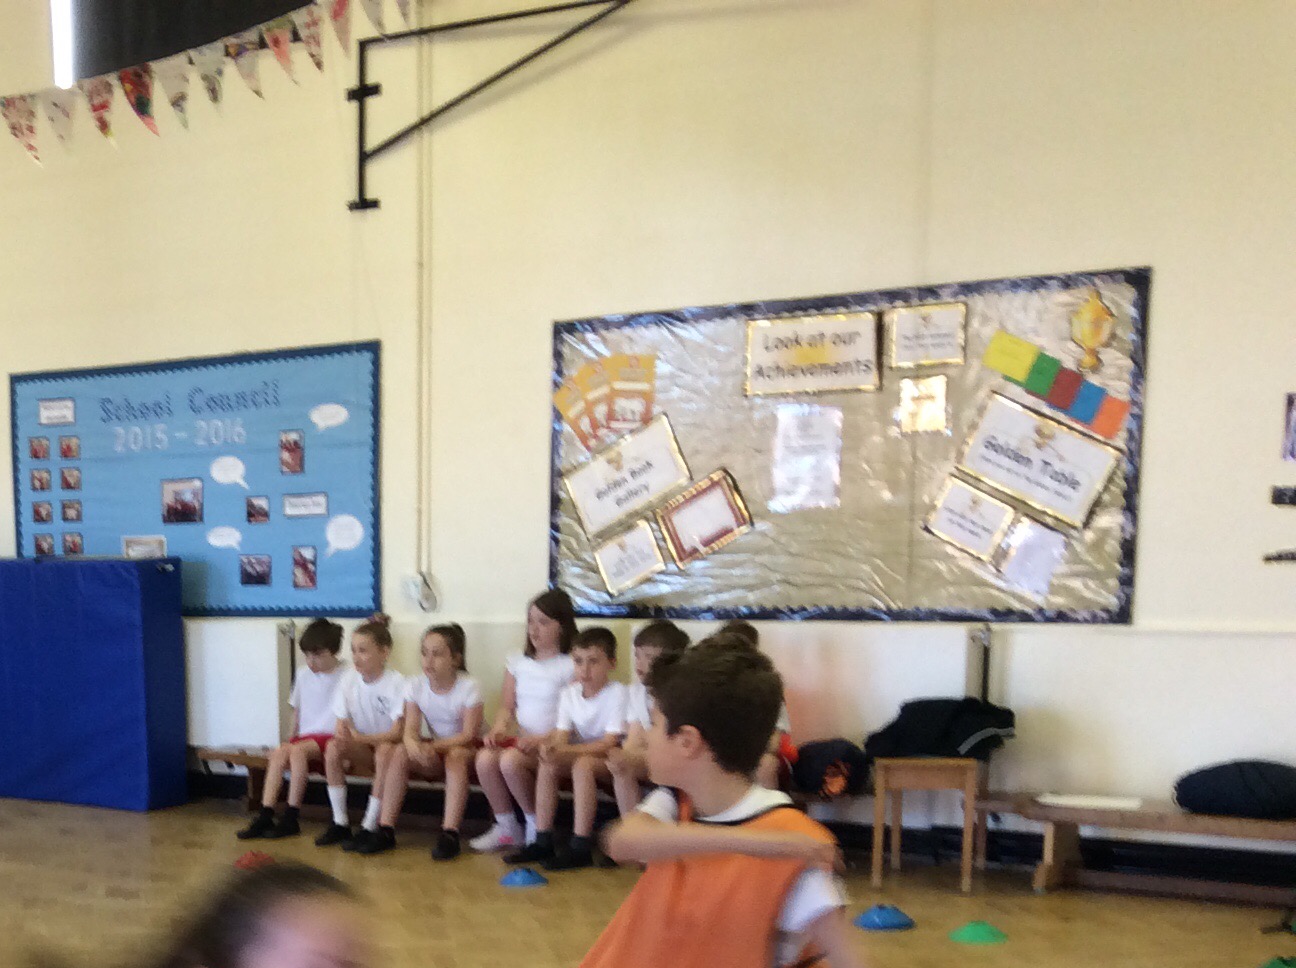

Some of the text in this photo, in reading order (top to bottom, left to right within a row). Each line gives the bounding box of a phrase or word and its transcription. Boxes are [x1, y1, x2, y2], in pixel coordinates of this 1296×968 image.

[99, 391, 174, 424] School
[188, 379, 281, 416] Council
[113, 424, 169, 453] 2015
[194, 417, 248, 446] 2016
